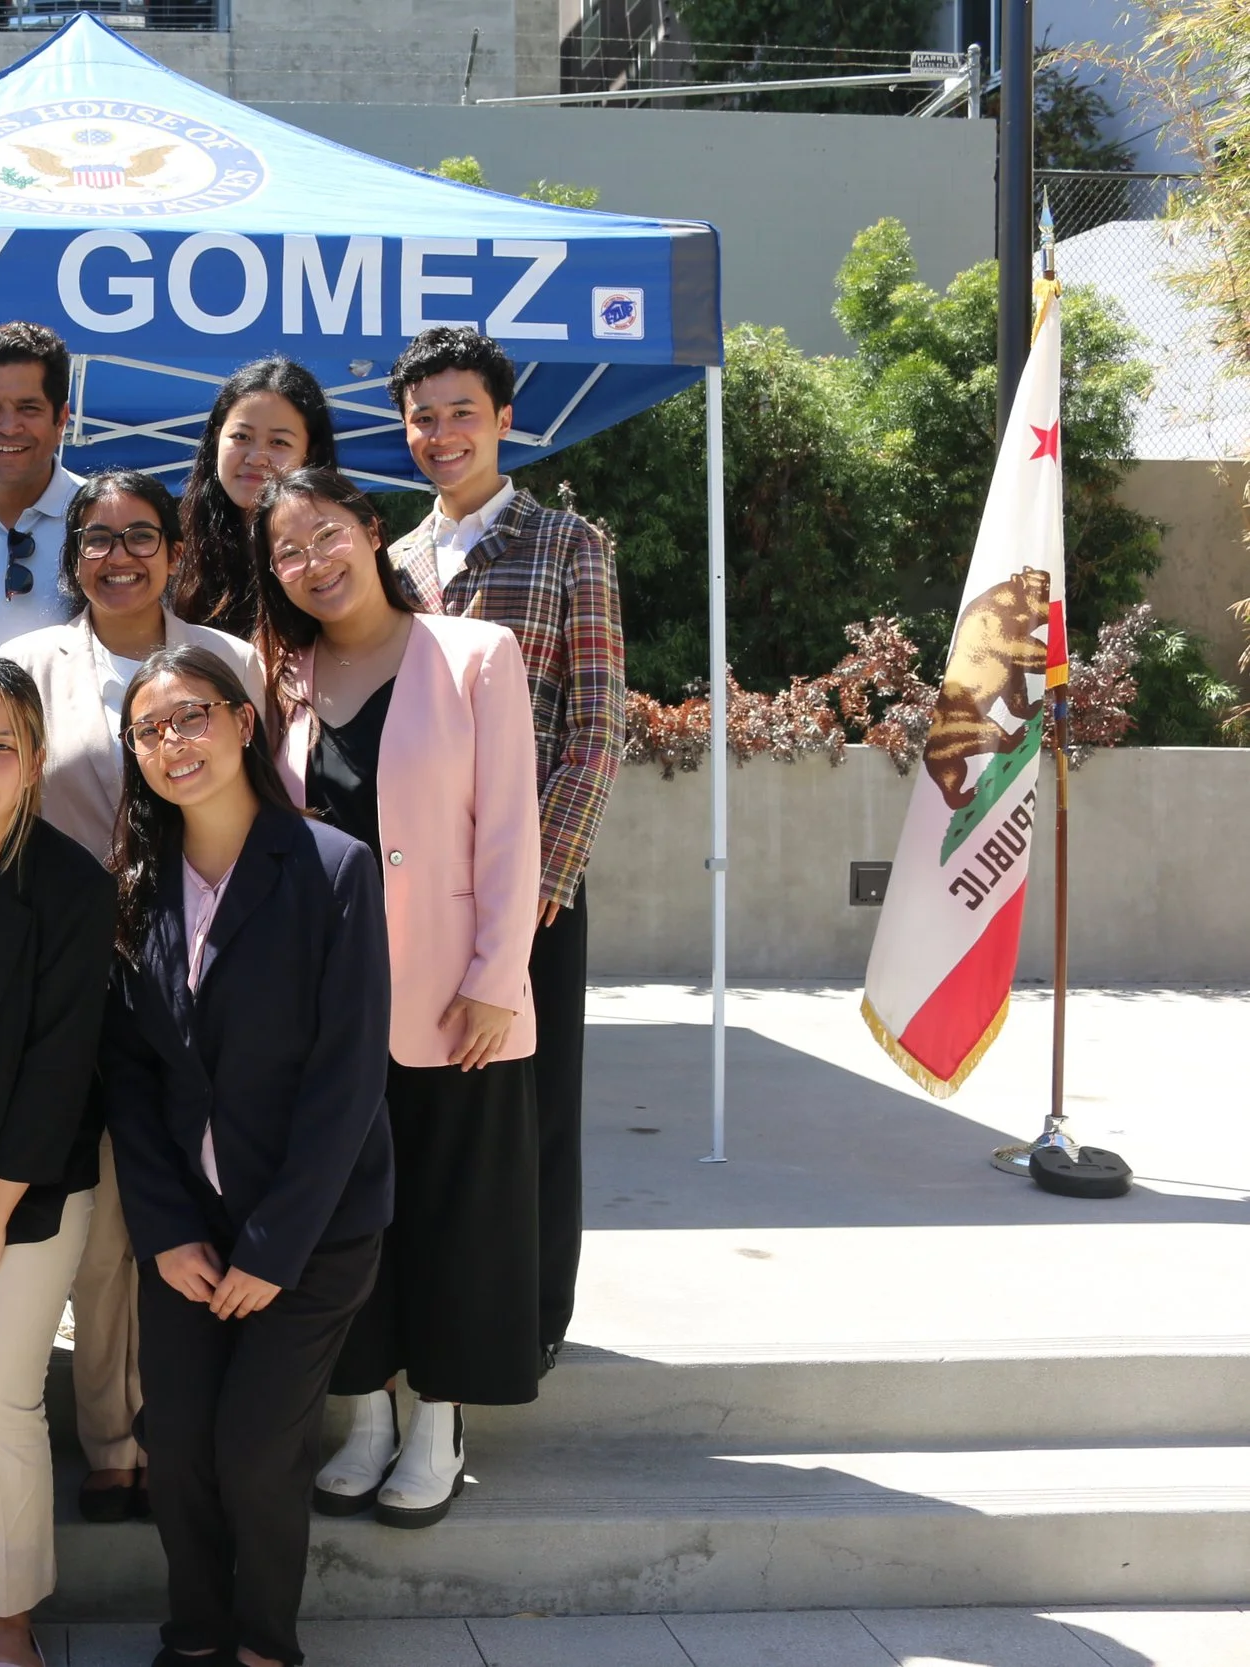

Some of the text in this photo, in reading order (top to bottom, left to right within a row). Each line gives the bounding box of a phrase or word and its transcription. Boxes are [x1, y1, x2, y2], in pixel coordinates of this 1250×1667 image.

[917, 55, 954, 64] HARRIS
[32, 102, 187, 131] HOUSE
[185, 128, 239, 150] OF
[57, 229, 569, 340] GOMEZ
